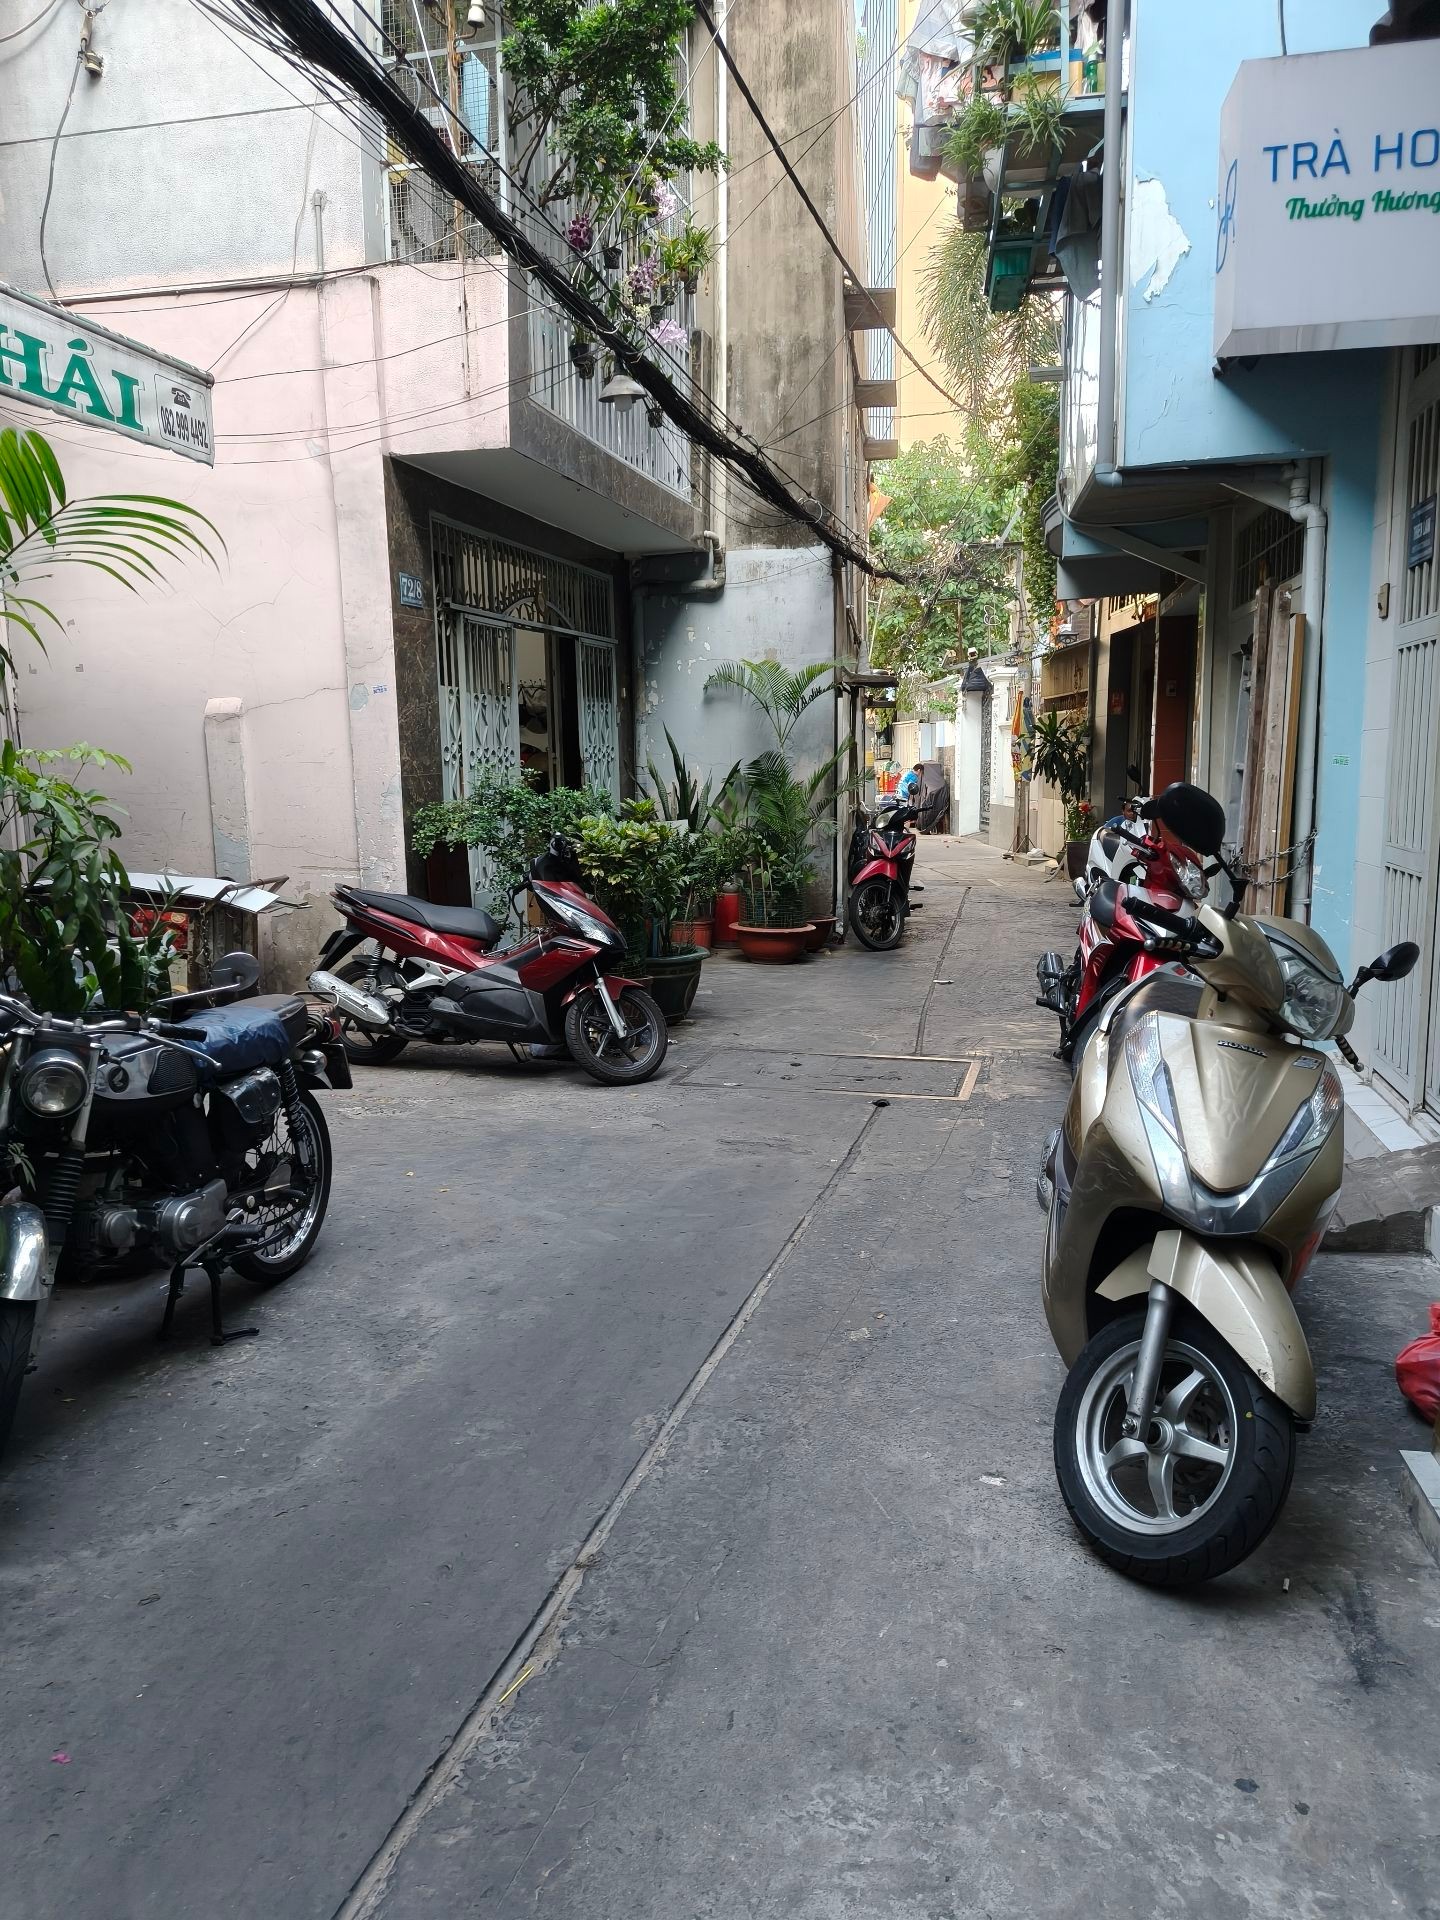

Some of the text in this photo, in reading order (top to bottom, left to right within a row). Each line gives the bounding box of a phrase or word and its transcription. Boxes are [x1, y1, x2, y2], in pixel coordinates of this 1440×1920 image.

[1263, 128, 1350, 182] TRÀ
[1285, 189, 1440, 221] Thưởng Hương
[175, 411, 190, 442] 999
[190, 417, 209, 449] 4492
[401, 577, 422, 600] 72/8
